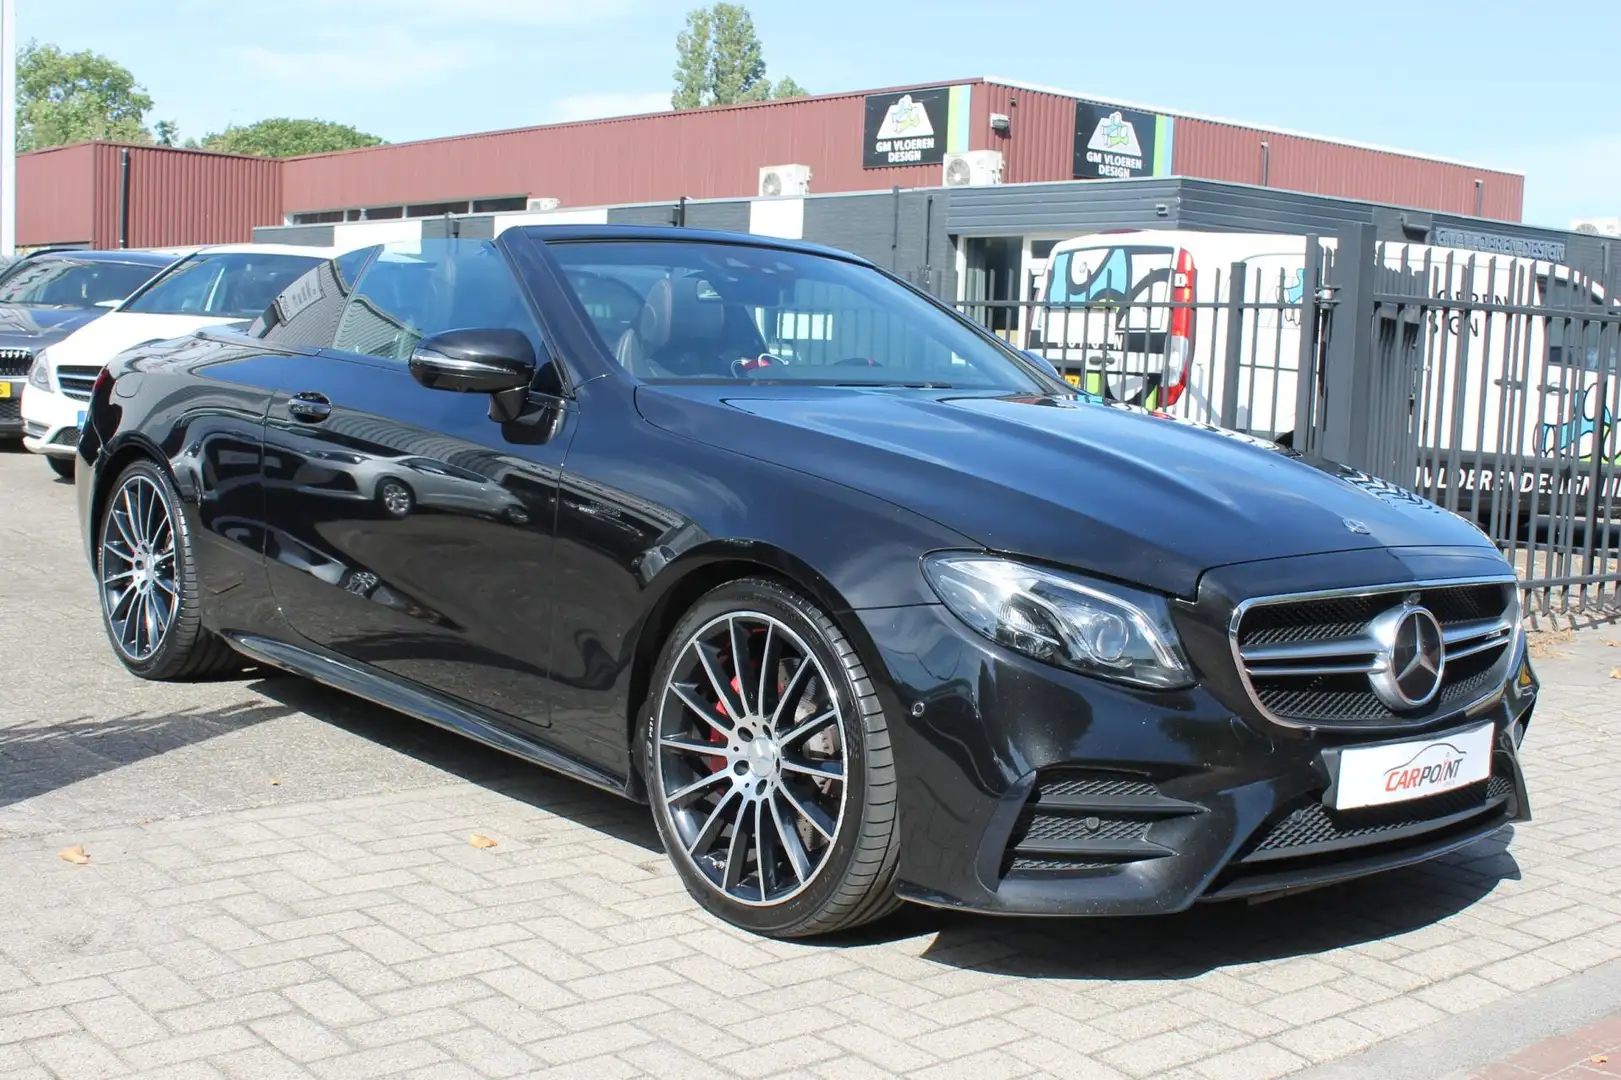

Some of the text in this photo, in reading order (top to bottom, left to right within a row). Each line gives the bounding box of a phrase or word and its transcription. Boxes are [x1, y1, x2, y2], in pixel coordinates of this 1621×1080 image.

[876, 138, 935, 152] GM VLOEREN
[888, 150, 921, 163] DESIGN
[1086, 151, 1142, 170] GM VLOEREN
[1098, 164, 1130, 178] DESIGN
[1385, 757, 1464, 792] CARPOINT
